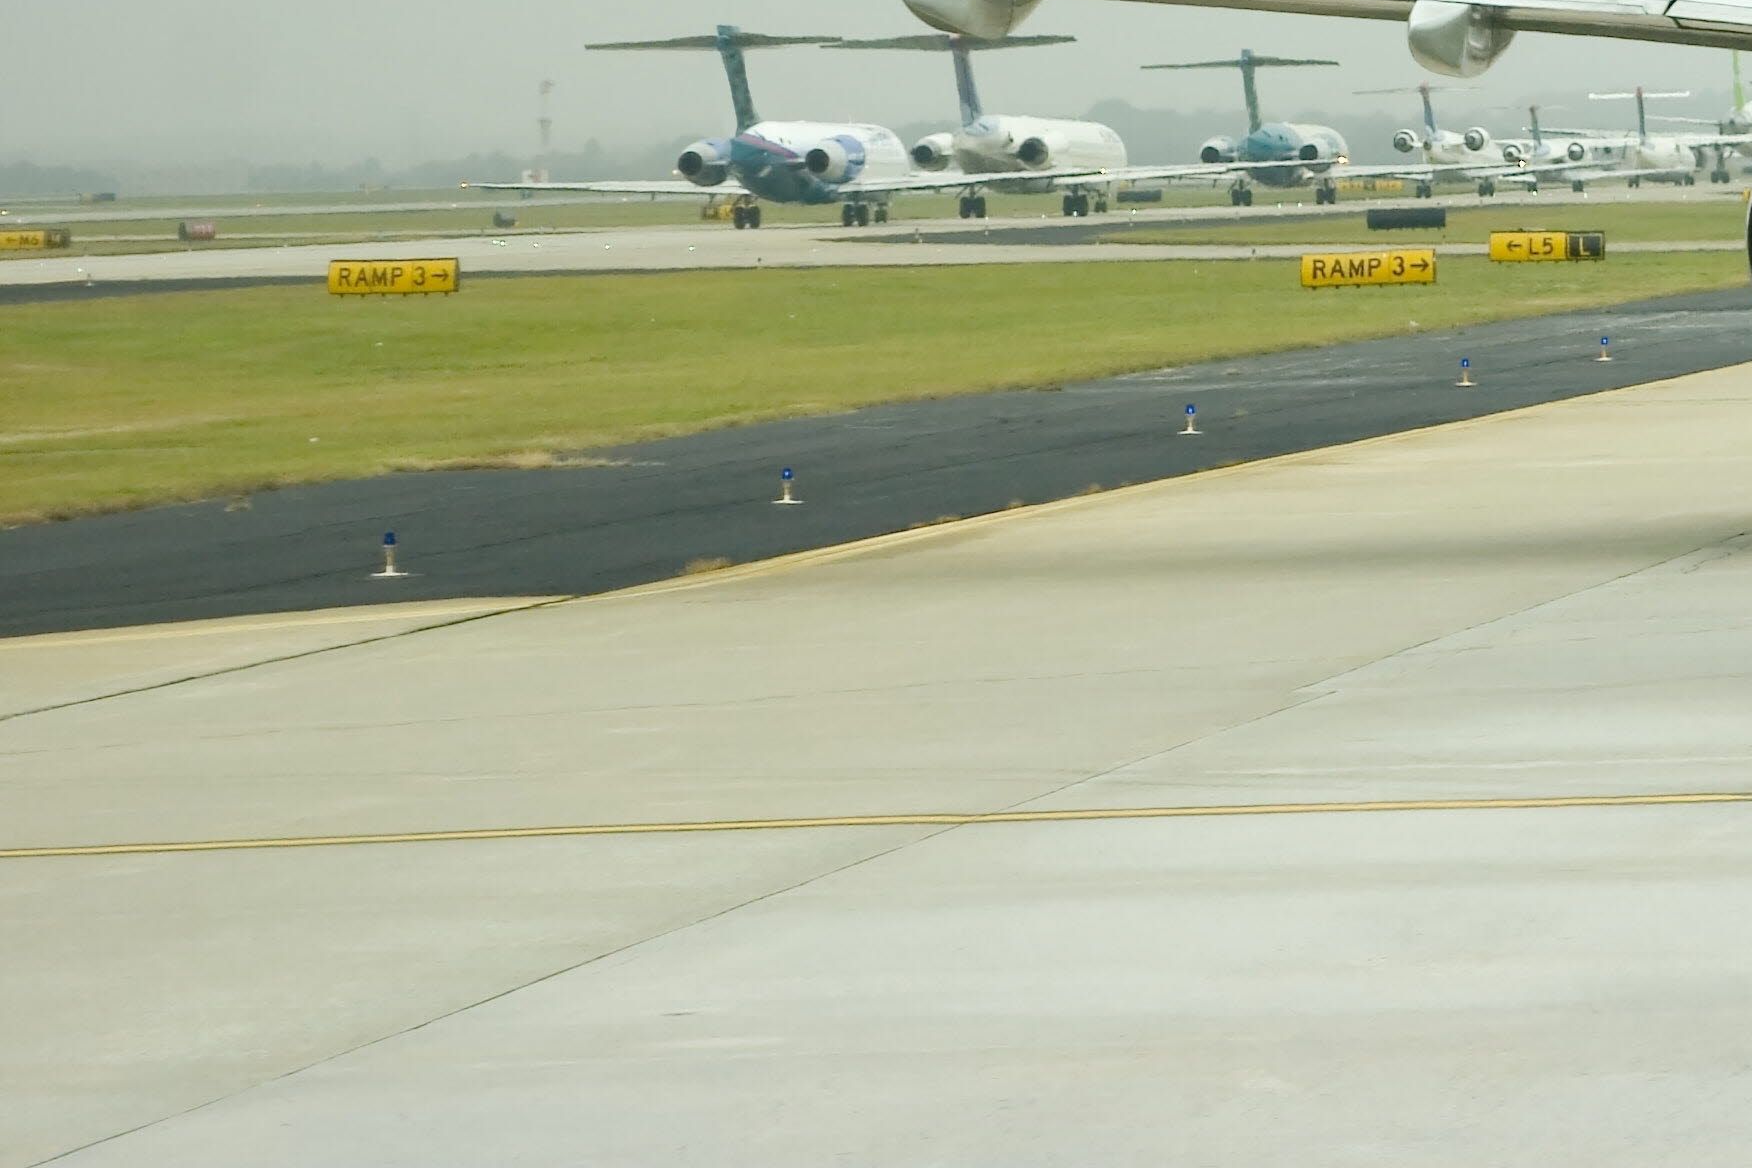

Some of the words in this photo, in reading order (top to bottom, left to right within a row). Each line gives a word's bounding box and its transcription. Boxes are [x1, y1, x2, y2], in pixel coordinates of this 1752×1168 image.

[1529, 237, 1554, 256] L5
[1579, 235, 1591, 256] L
[338, 267, 404, 287] RAMP
[412, 266, 426, 286] 3
[1312, 257, 1382, 280] RAMP
[1391, 256, 1405, 277] 3
